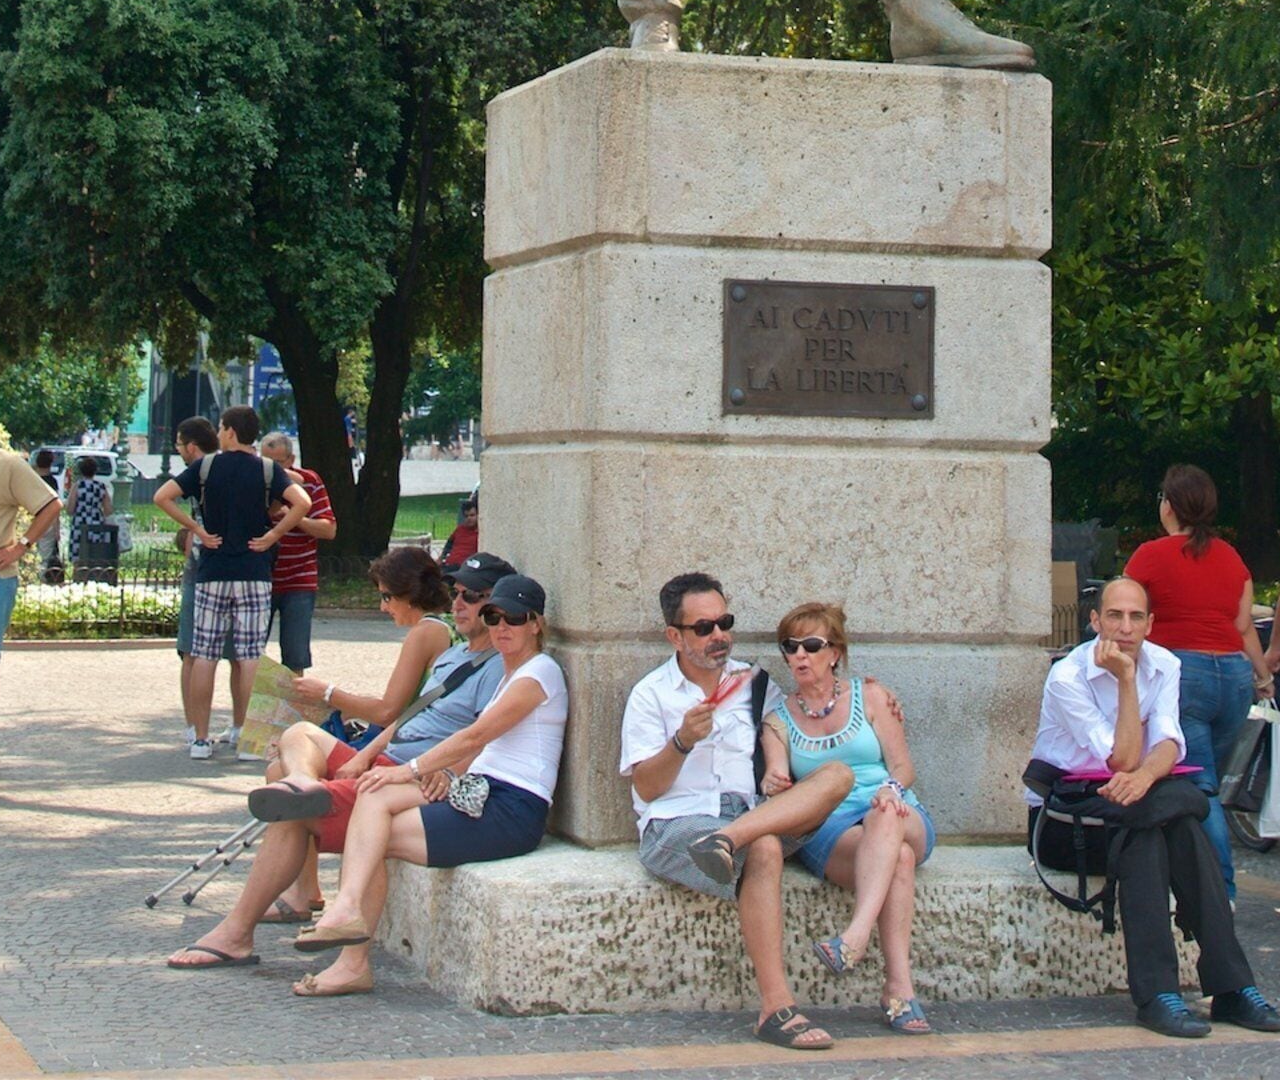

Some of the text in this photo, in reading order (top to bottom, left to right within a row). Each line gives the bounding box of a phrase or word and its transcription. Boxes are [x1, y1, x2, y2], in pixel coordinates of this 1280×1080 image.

[748, 306, 911, 334] AI CADVTI
[804, 337, 856, 362] PER
[746, 366, 782, 392] LA
